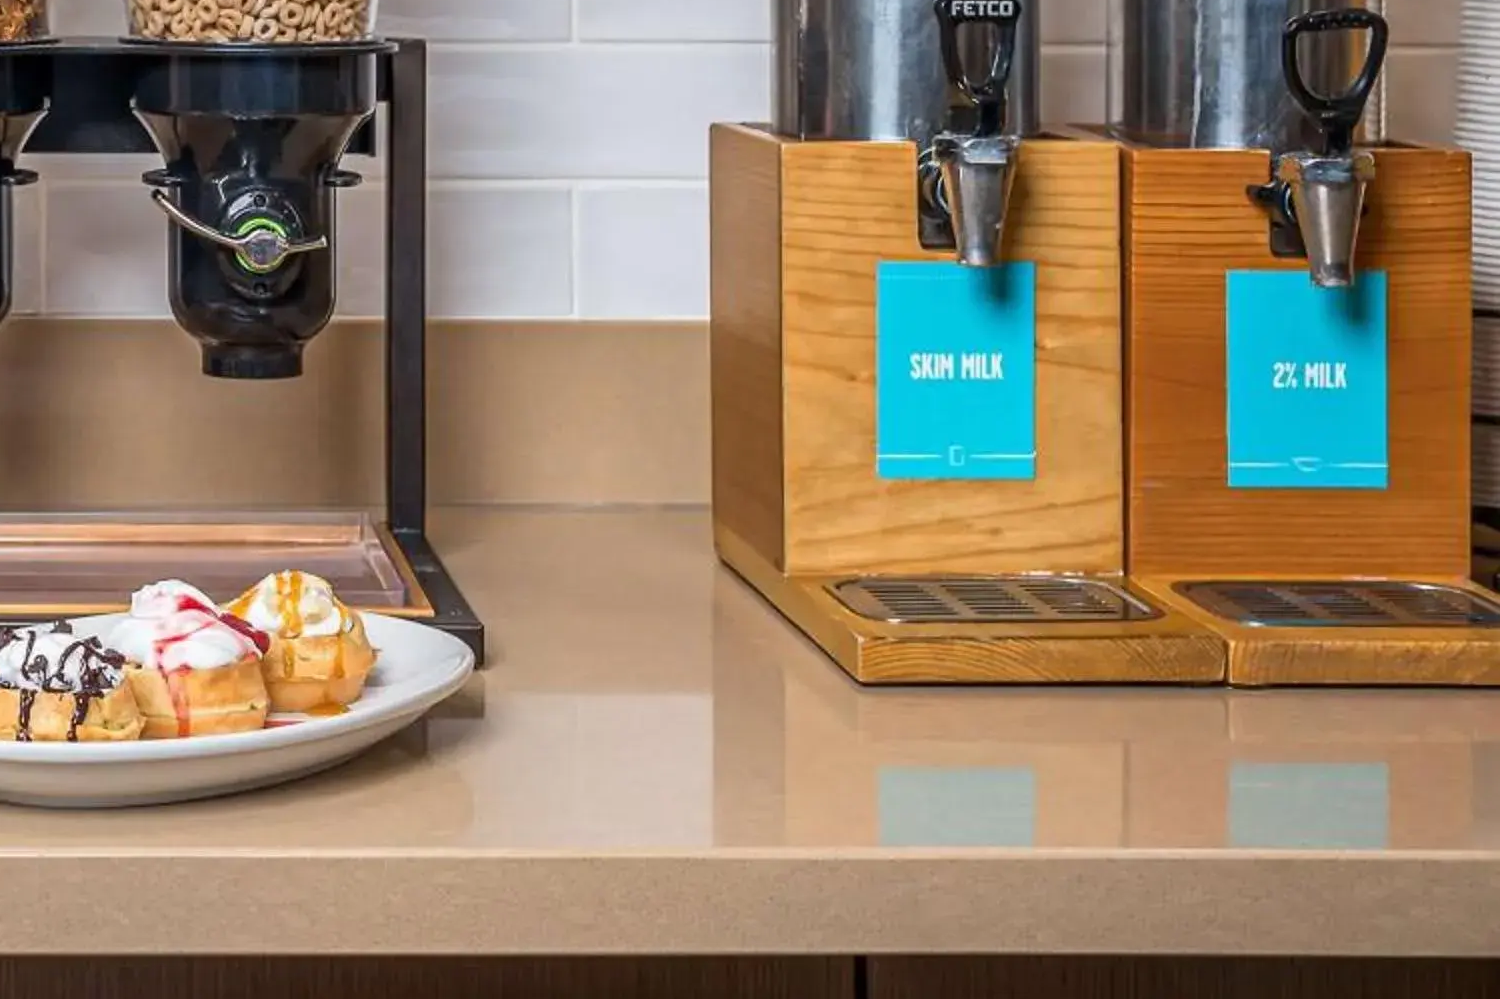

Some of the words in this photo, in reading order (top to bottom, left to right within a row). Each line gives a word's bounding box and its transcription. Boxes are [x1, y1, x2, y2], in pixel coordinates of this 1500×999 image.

[951, 0, 1014, 16] FETCO
[909, 353, 954, 380] SKIM
[961, 353, 1004, 380] MILK
[1273, 362, 1298, 389] 2%
[1304, 362, 1347, 389] MILK
